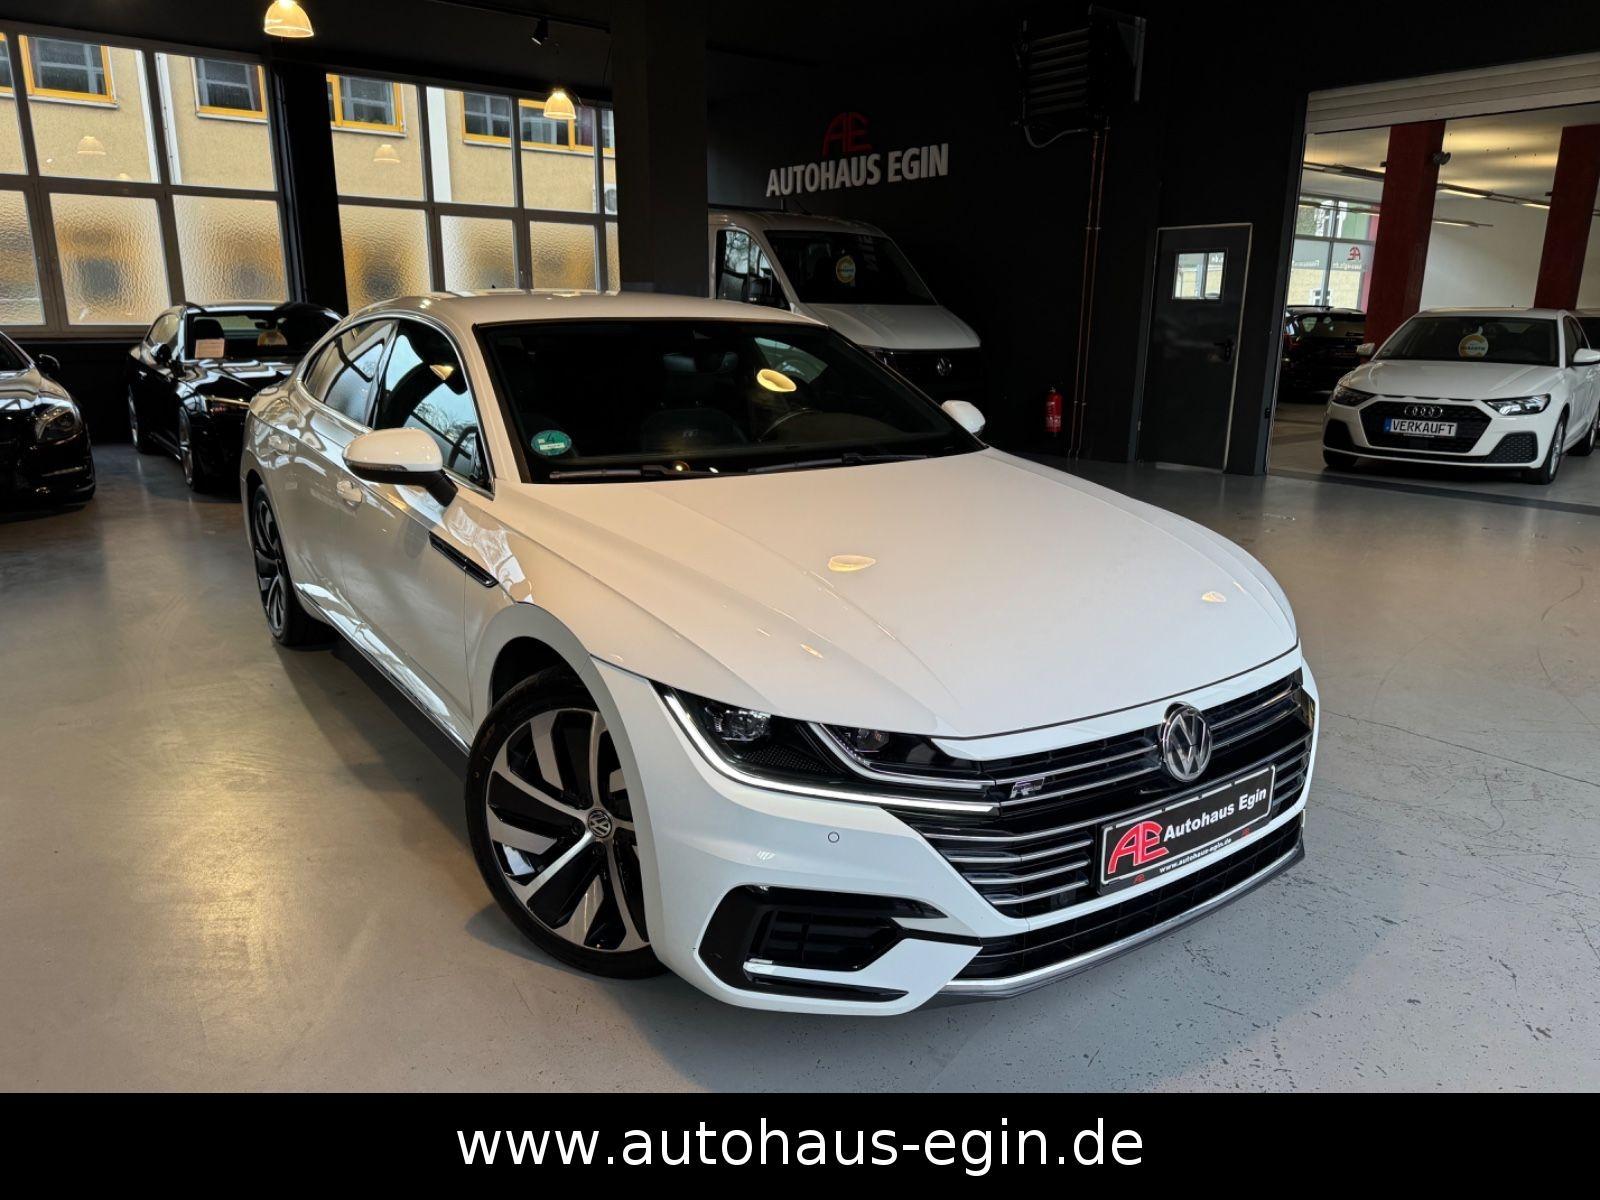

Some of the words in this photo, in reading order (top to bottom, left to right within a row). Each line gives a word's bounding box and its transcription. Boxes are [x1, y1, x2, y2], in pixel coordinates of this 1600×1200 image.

[765, 153, 882, 198] AUTOHAUS
[887, 143, 949, 183] EGIN
[1392, 420, 1455, 435] VERKAUFT
[1163, 802, 1235, 842] Autohaus
[1238, 787, 1267, 811] Egin
